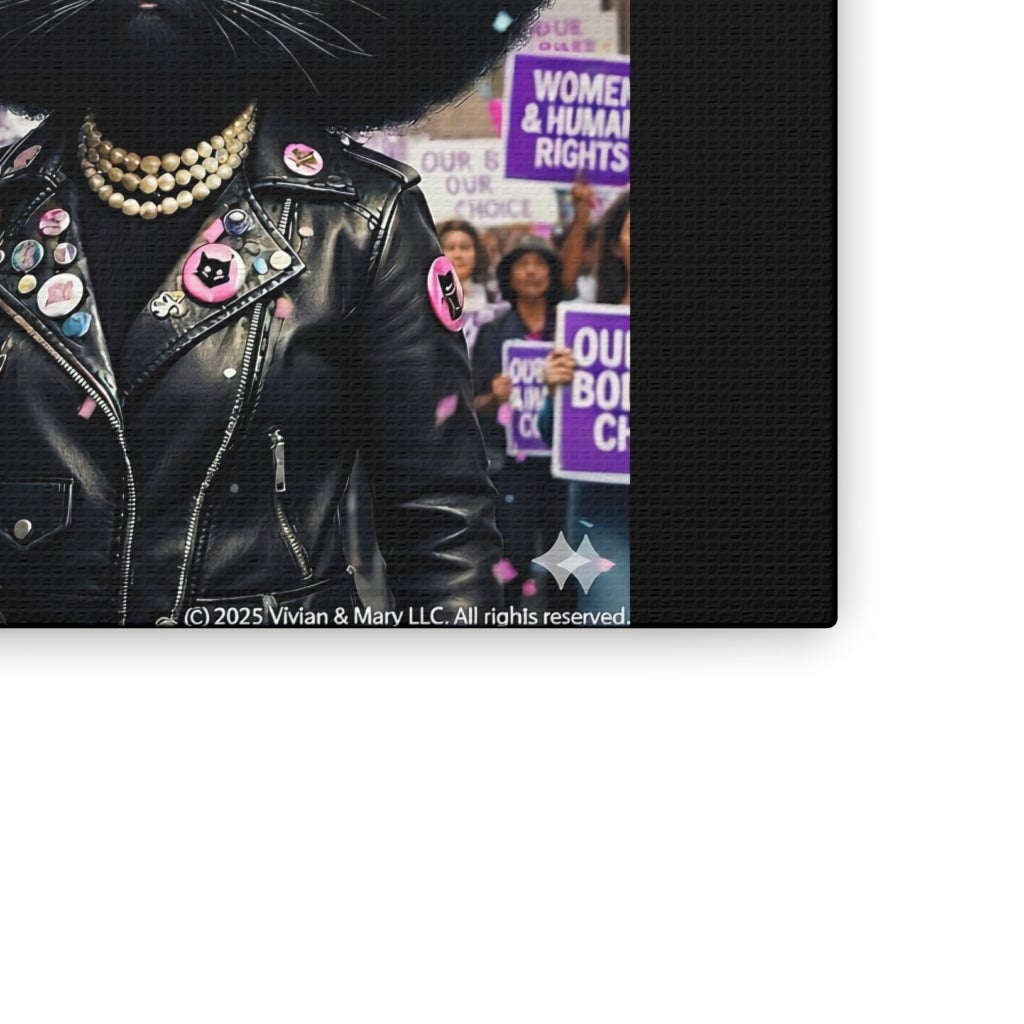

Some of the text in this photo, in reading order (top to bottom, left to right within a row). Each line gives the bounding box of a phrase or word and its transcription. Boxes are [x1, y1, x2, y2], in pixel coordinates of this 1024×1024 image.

[521, 102, 542, 134] &
[421, 150, 470, 172] OUR
[534, 137, 628, 173] RIGHTS
[446, 175, 492, 195] OUR
[573, 326, 630, 370] OU
